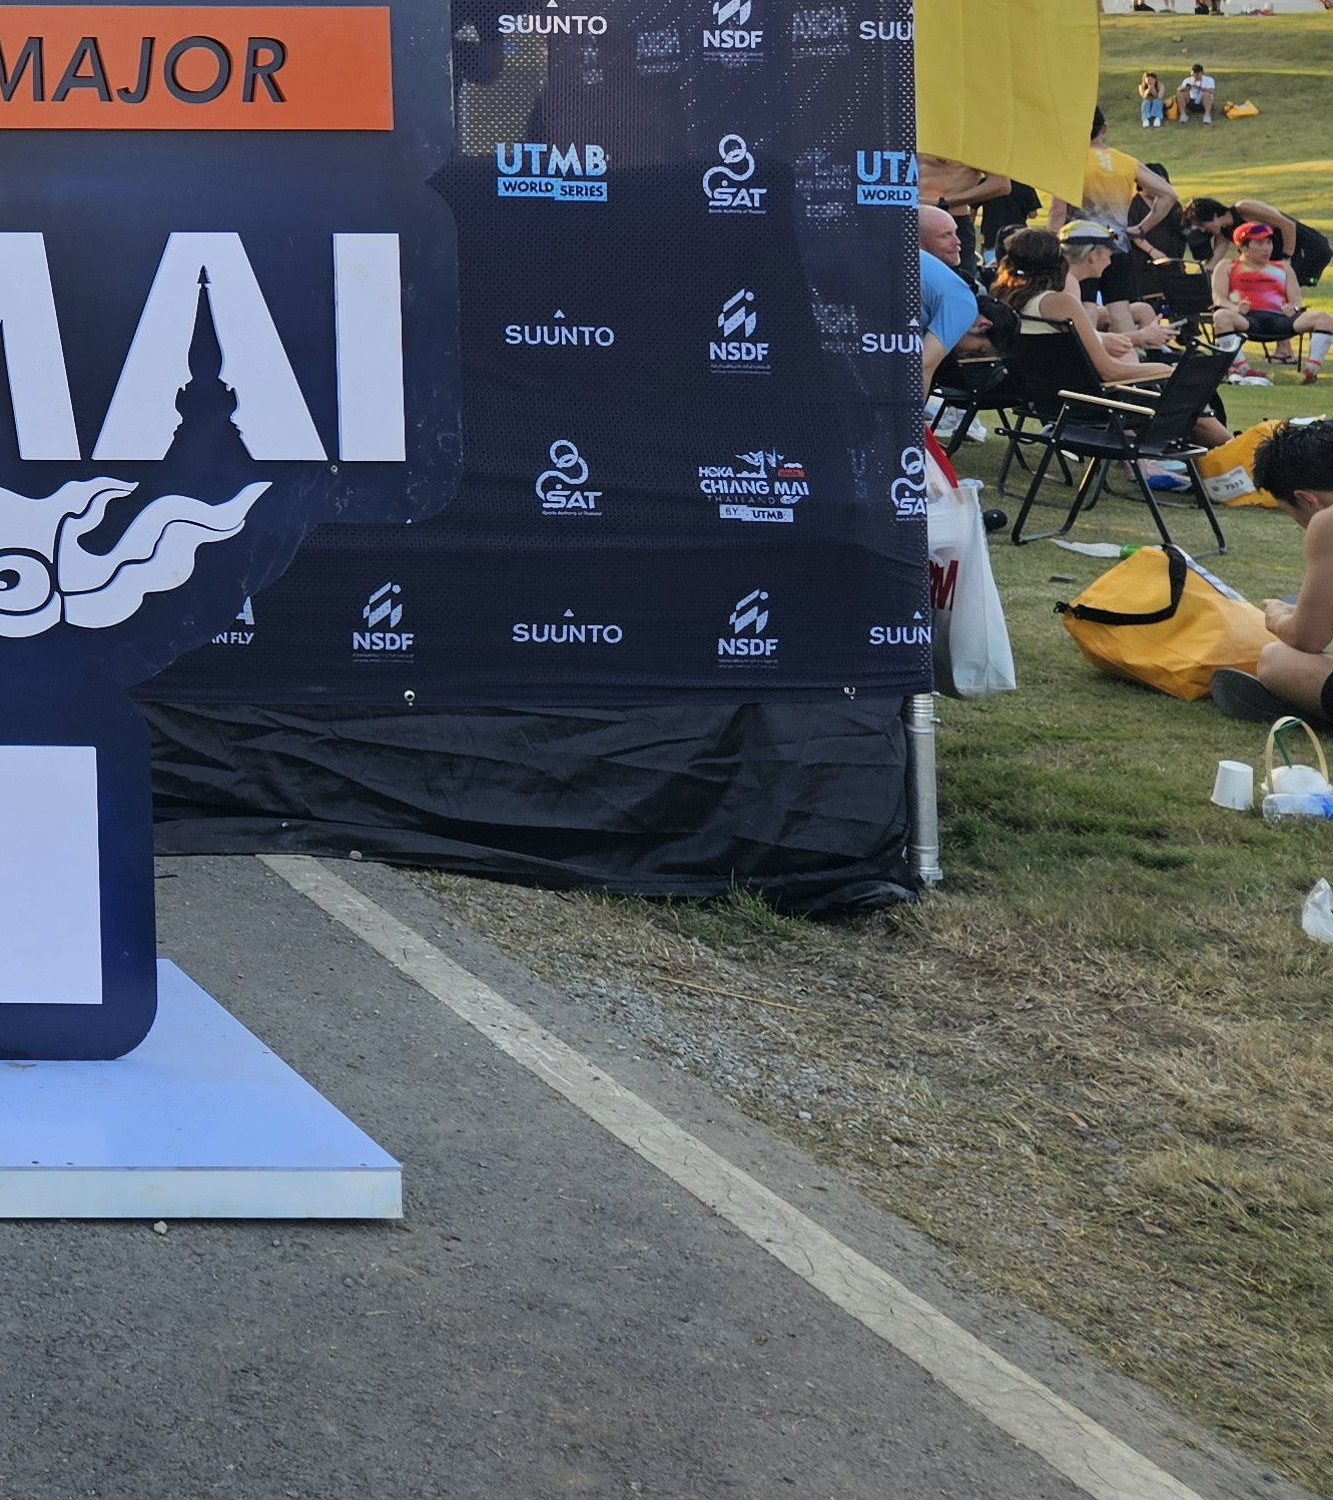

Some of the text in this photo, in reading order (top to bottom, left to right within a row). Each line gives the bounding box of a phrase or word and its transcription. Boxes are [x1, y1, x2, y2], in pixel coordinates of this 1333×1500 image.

[497, 13, 608, 36] SUUNTO
[702, 29, 763, 49] NSDF
[494, 142, 608, 176] UTMB
[502, 180, 604, 199] WORLD SERIES
[709, 187, 768, 207] SAT
[862, 188, 912, 201] WORLD
[504, 324, 615, 347] SUUNTO
[709, 341, 769, 361] NSDF
[698, 465, 734, 478] HOKA
[699, 480, 810, 496] CHIANG MAI
[541, 490, 603, 509] SAT
[725, 506, 784, 520] BY UTMB
[352, 632, 414, 652] NSDF
[512, 622, 623, 644] SUUNTO
[718, 637, 779, 657] NSDF
